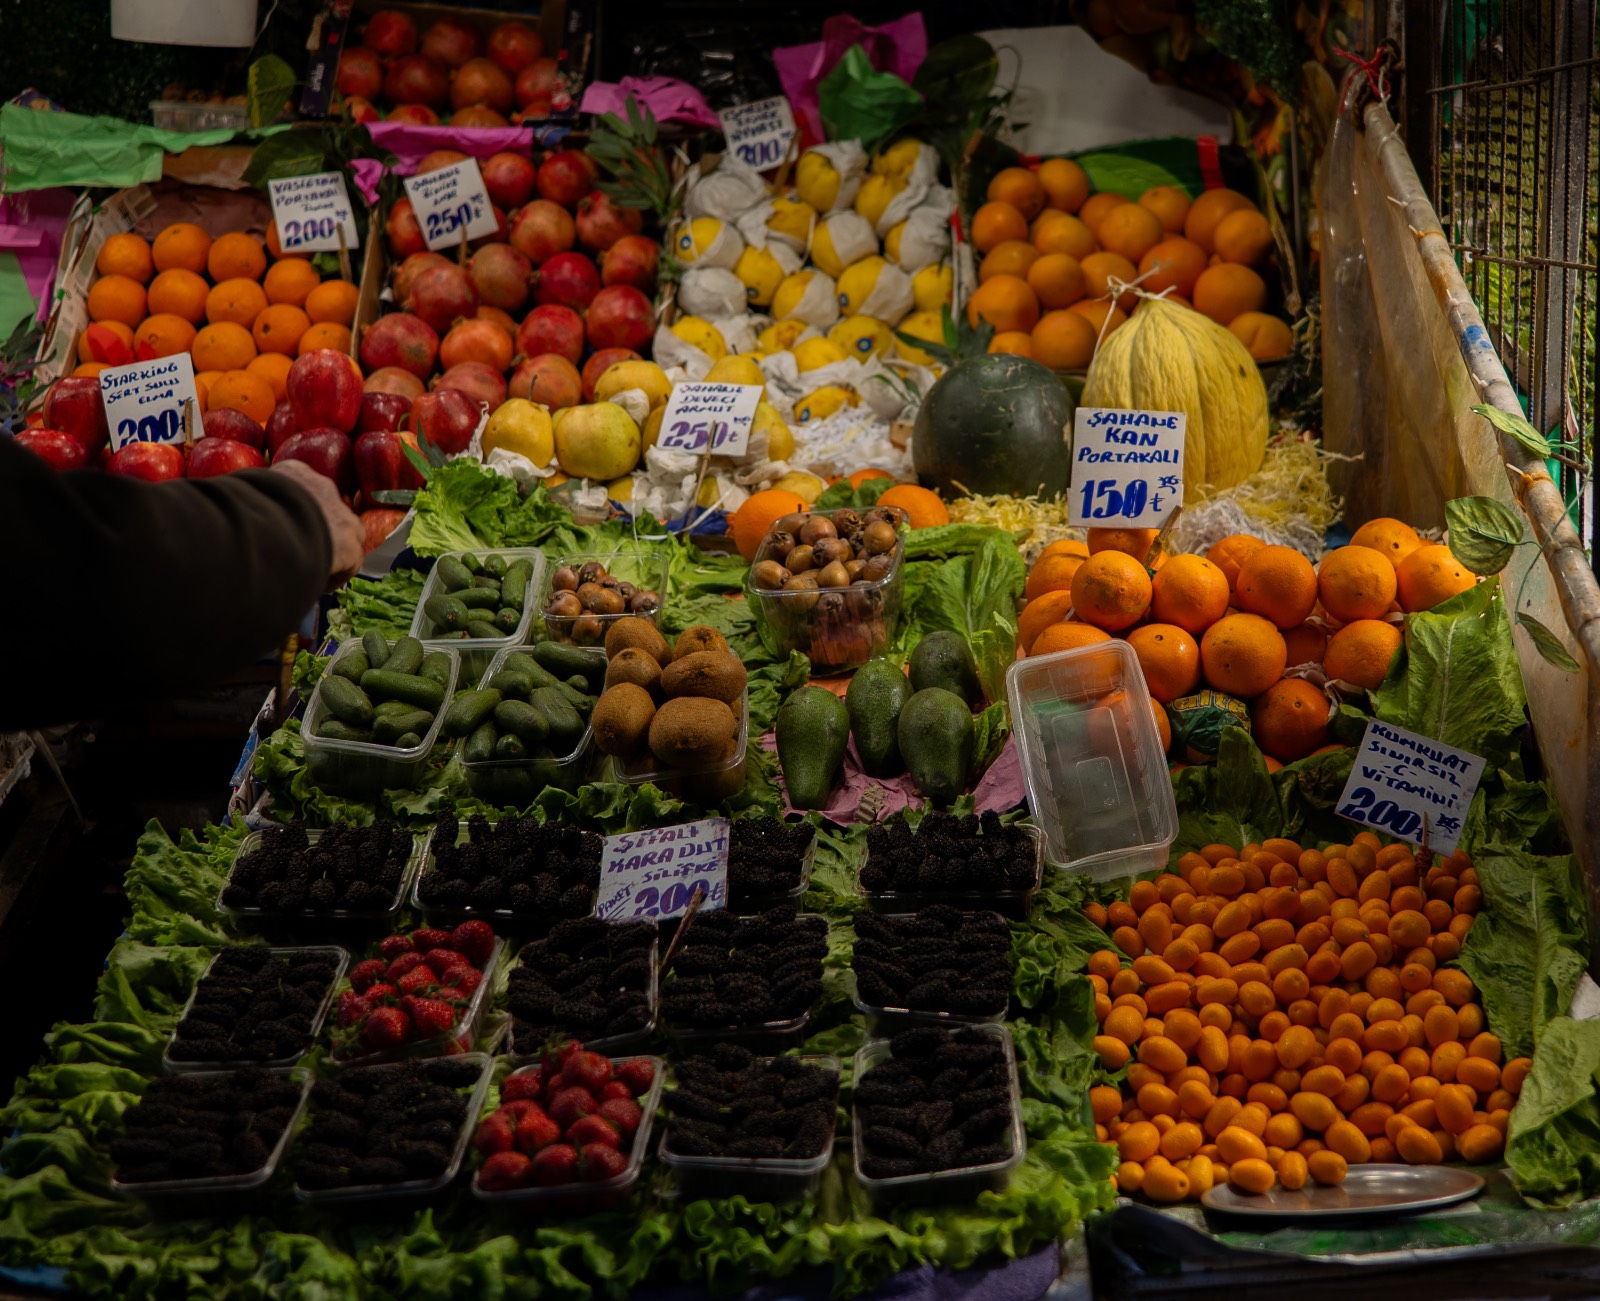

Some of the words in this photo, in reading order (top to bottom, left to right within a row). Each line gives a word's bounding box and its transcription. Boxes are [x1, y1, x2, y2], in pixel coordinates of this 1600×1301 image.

[107, 386, 140, 405] SERT
[138, 389, 174, 405] ELMA
[675, 405, 735, 415] ARMUT
[1087, 412, 1179, 430] ŞAHANE
[1105, 427, 1160, 446] KAN
[1078, 447, 1179, 464] PORTAKALI
[1370, 723, 1472, 773] KUMKUAT
[1368, 740, 1461, 788] SINIRSIZ
[1362, 765, 1459, 809] VİTAMİNİ
[608, 847, 675, 873] KARA
[678, 837, 727, 859] DUT
[597, 885, 632, 918] PAKET
